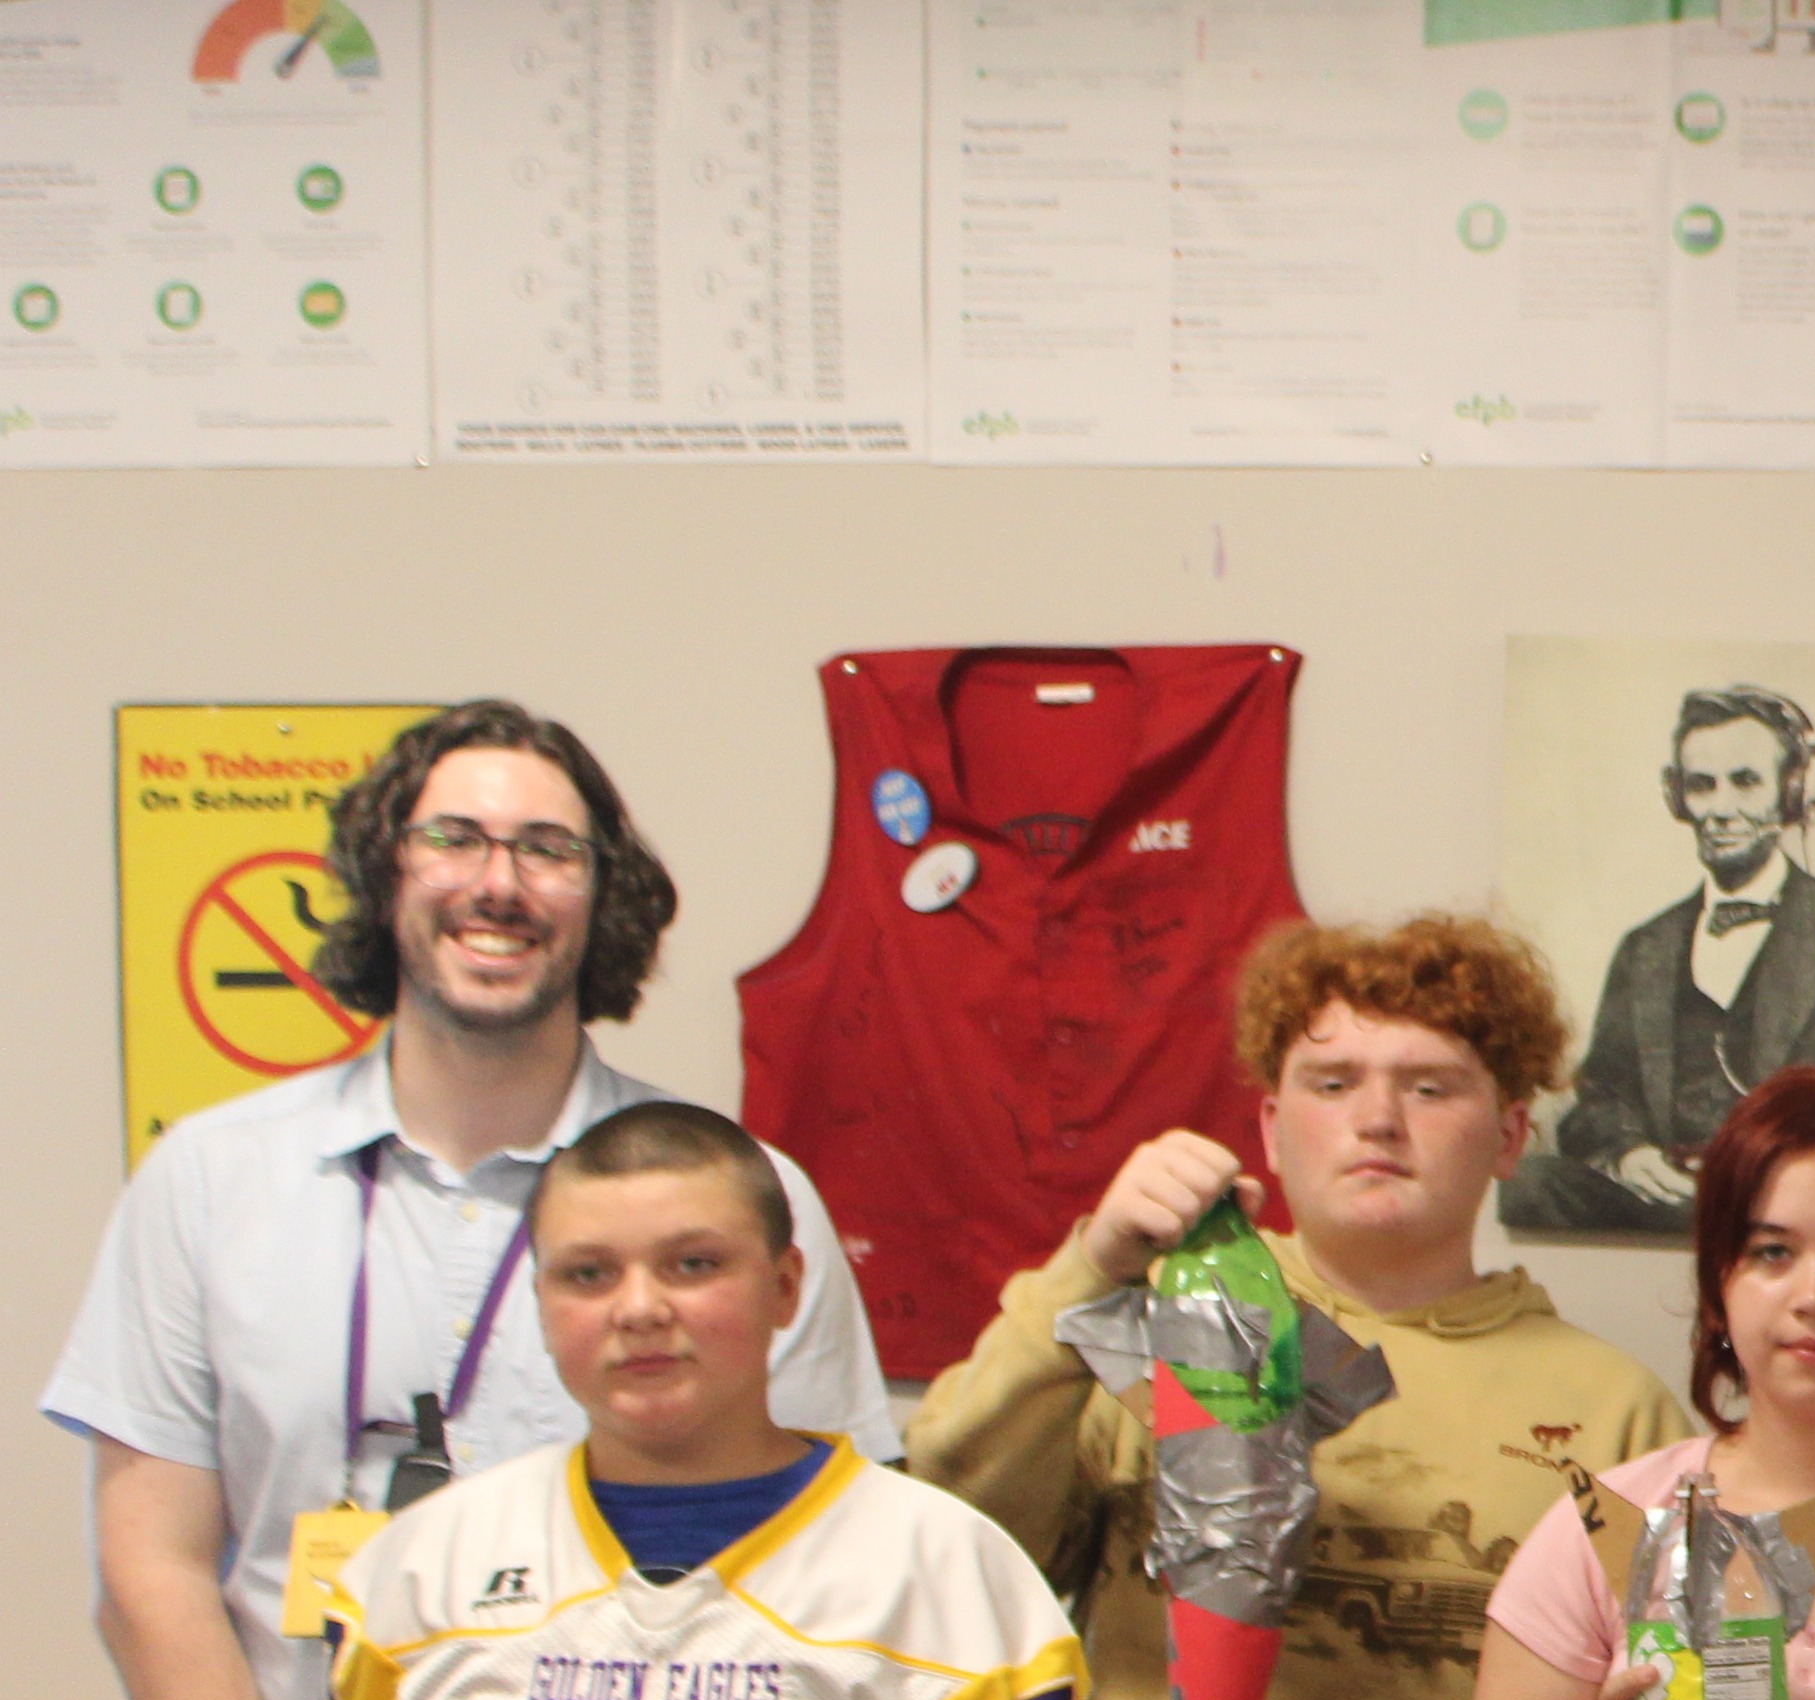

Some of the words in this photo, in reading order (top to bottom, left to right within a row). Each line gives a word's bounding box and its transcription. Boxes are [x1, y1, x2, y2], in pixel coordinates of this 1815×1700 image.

[140, 754, 188, 779] No
[201, 753, 351, 780] Tobacco
[141, 791, 179, 811] On
[192, 789, 290, 811] School
[1129, 820, 1191, 854] ACE
